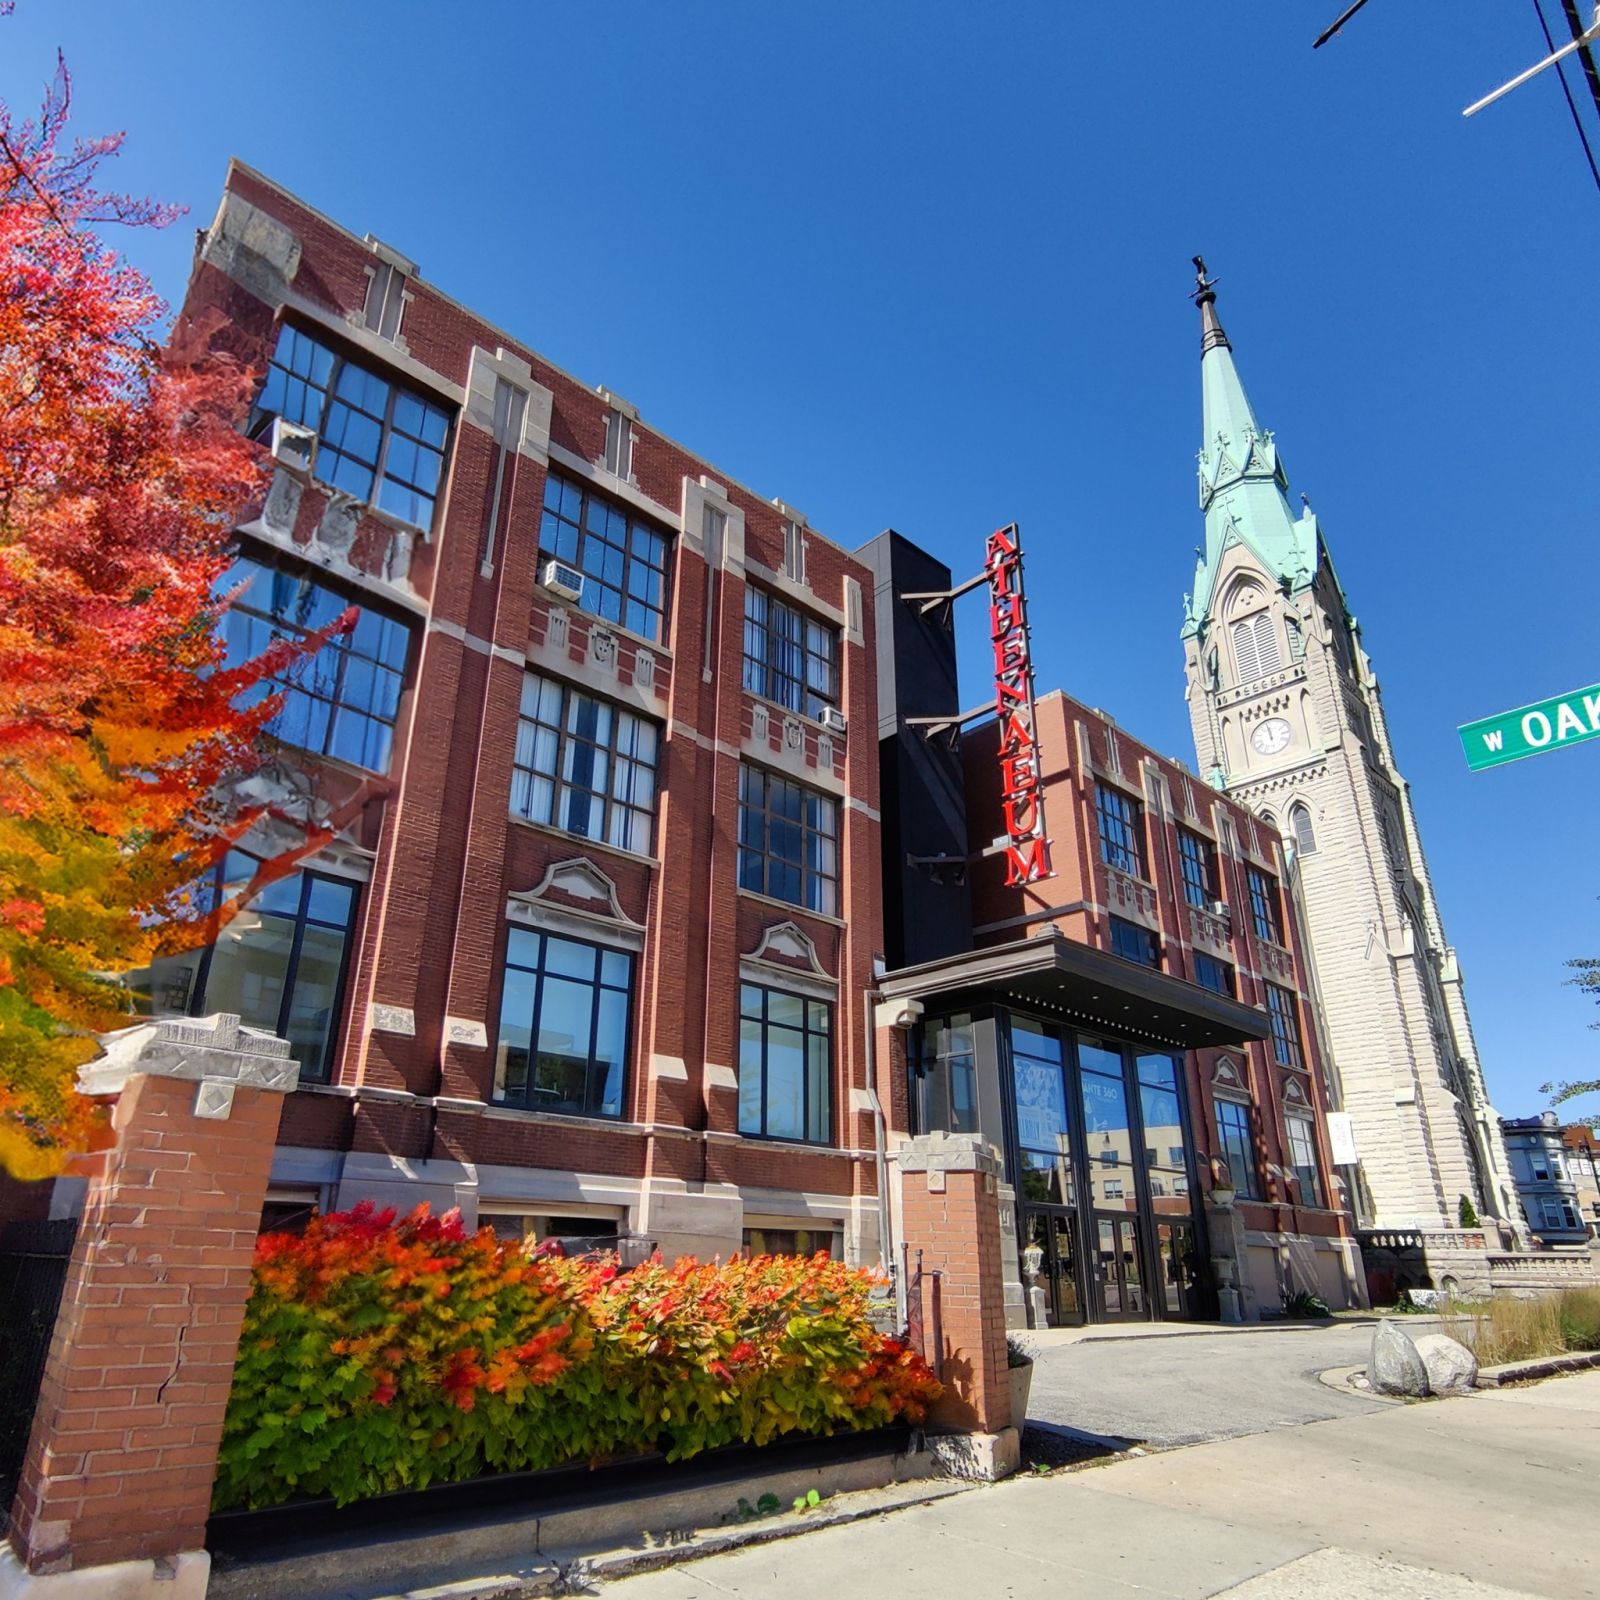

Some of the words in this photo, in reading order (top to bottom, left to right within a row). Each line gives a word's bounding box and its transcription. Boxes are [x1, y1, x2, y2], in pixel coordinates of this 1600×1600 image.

[985, 528, 1049, 886] ATHENAEUM
[1482, 730, 1503, 752] W
[1082, 1082, 1101, 1096] ANTE
[1102, 1086, 1118, 1099] 360
